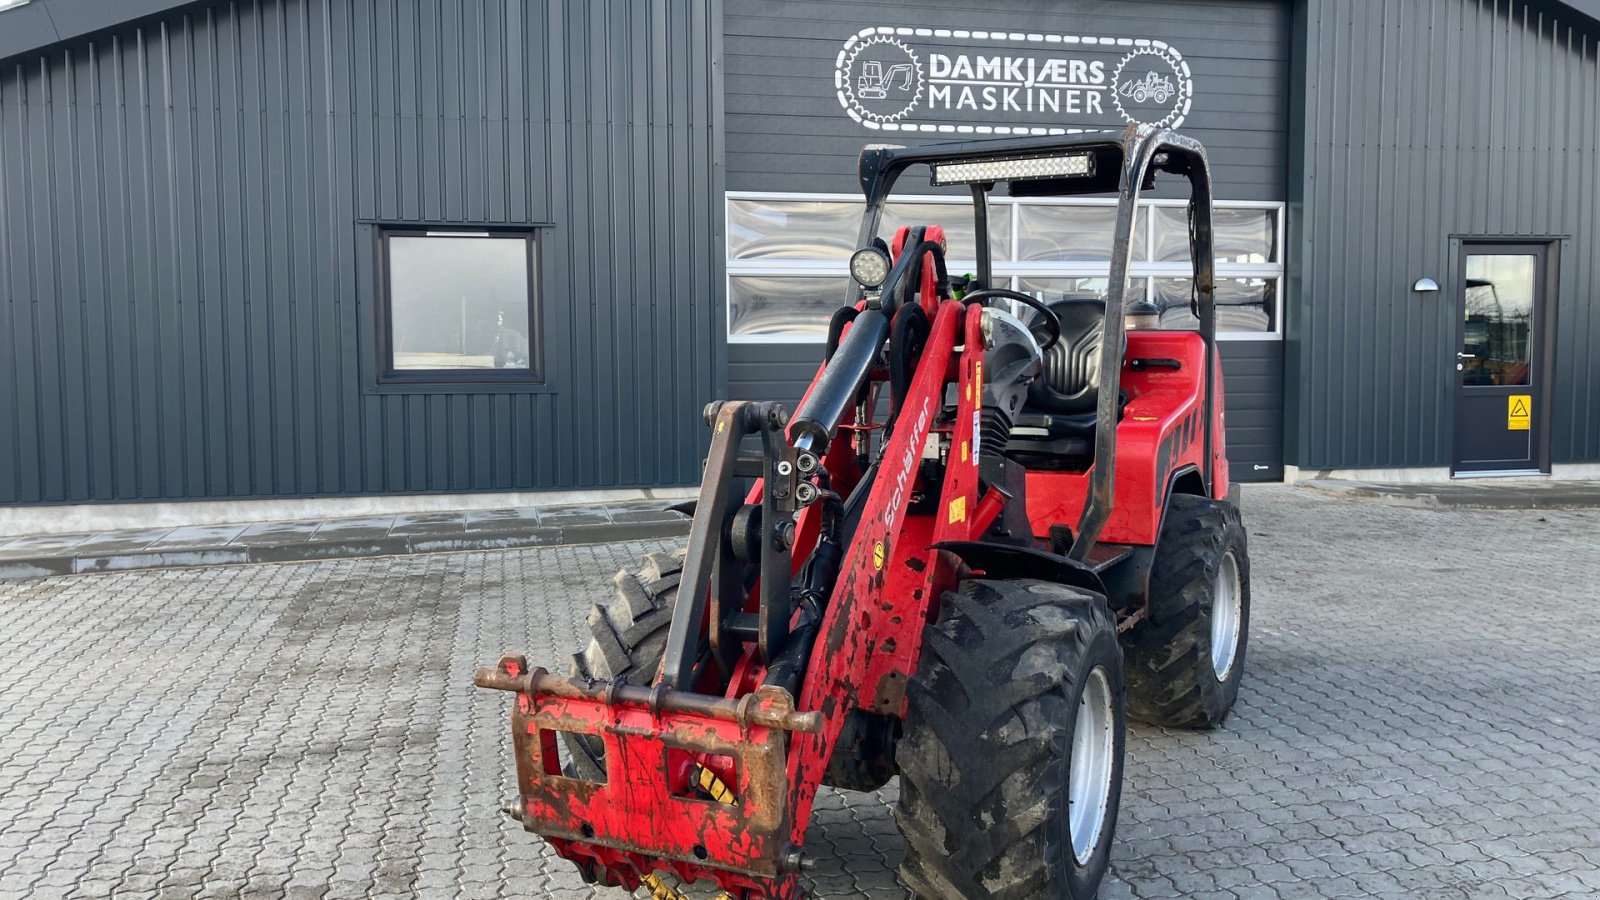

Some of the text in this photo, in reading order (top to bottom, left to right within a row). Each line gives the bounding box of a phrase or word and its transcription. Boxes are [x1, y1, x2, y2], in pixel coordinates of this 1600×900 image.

[929, 53, 1105, 88] DAMKJÆRS
[929, 86, 1104, 115] MASKINER
[884, 396, 930, 528] Schäffer
